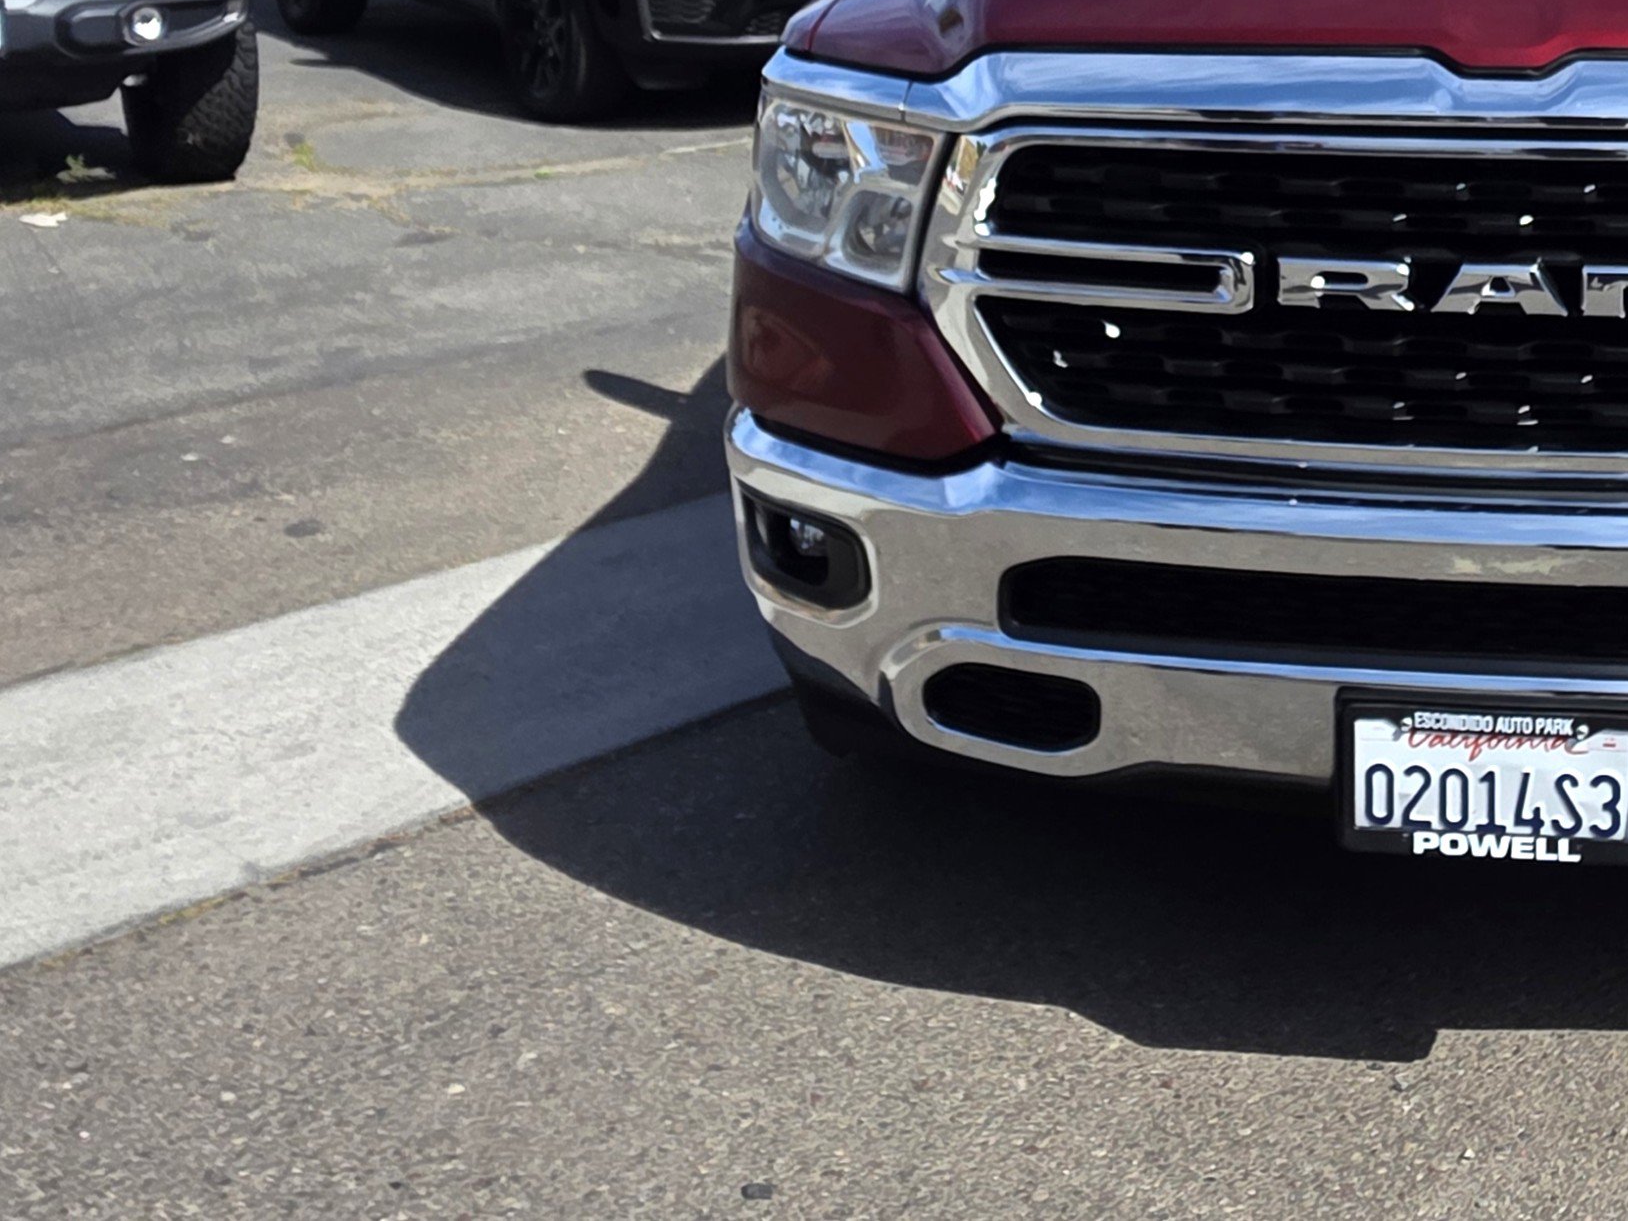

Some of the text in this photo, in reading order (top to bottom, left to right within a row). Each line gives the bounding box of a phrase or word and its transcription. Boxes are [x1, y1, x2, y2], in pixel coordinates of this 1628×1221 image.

[1413, 711, 1575, 736] ESCONDIDO AUTO PARK
[1364, 763, 1622, 838] 02014S3
[1412, 831, 1582, 863] POWELL
